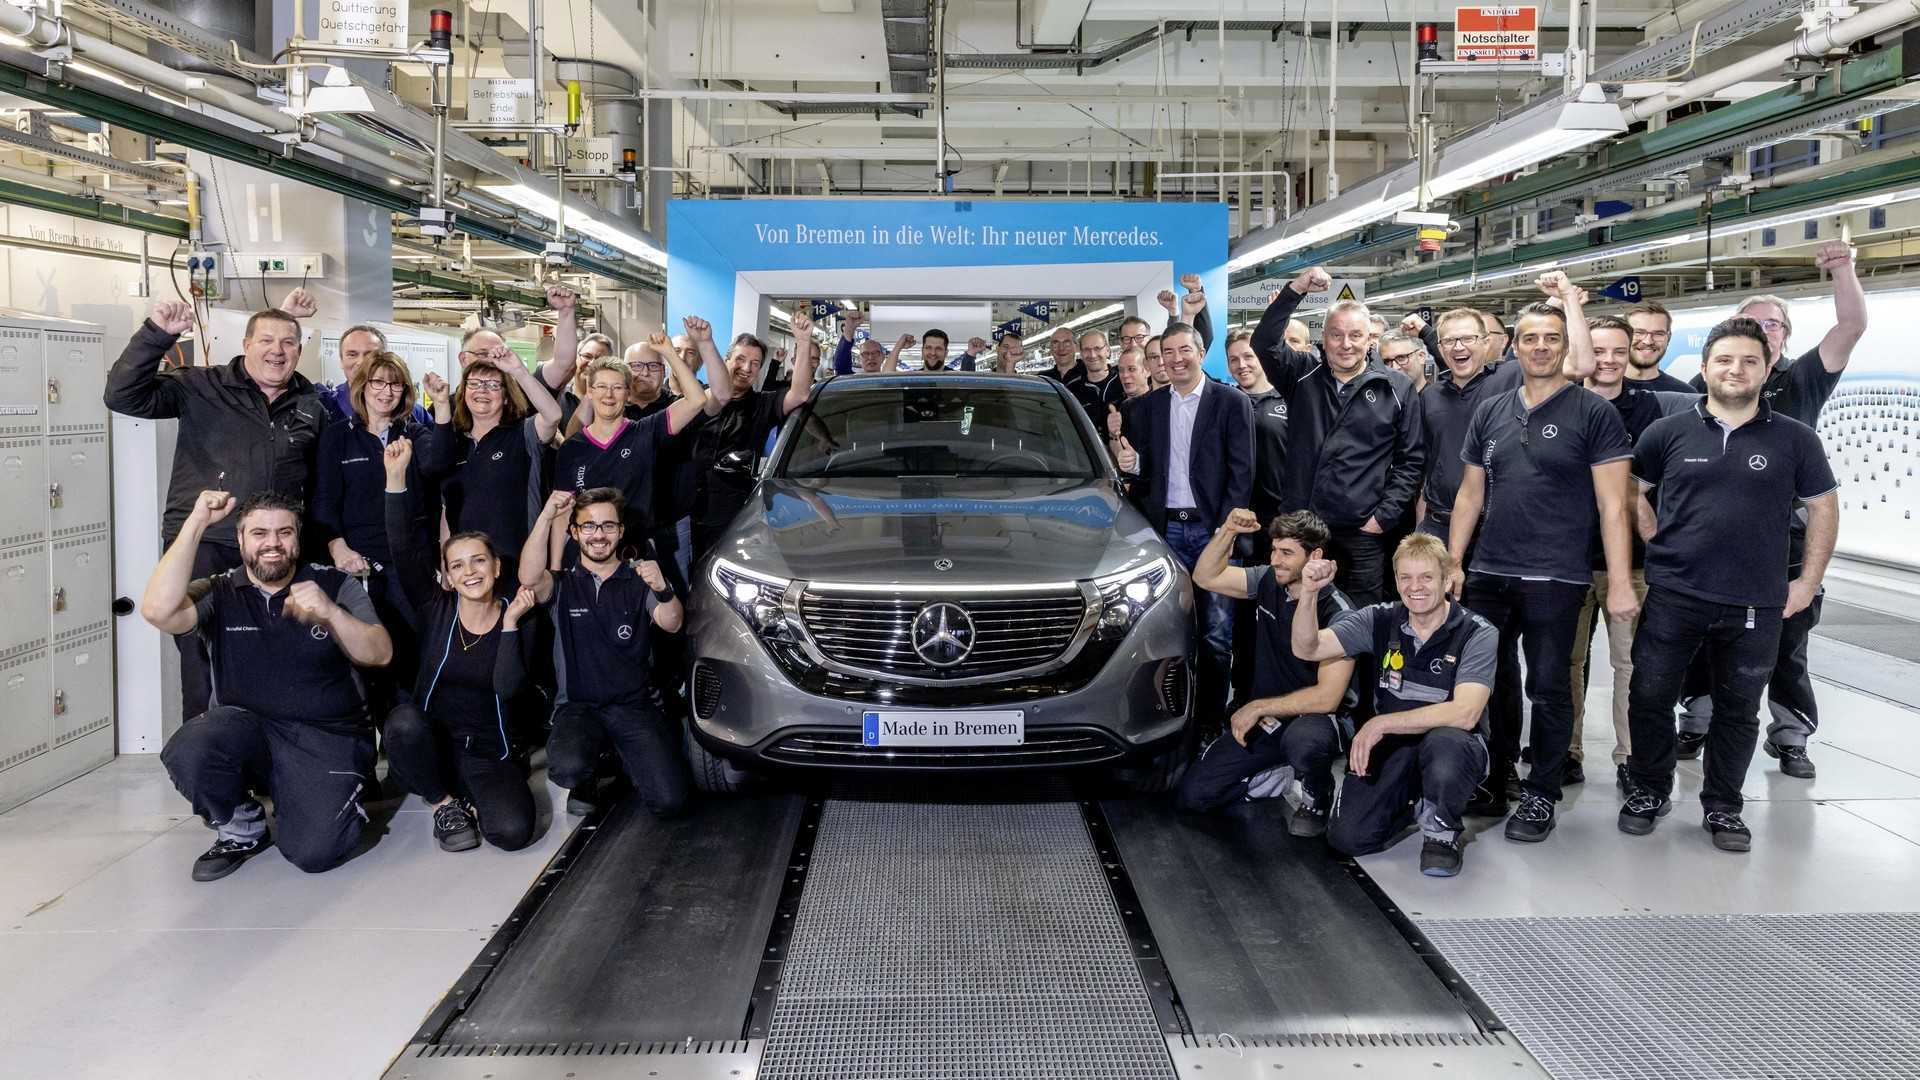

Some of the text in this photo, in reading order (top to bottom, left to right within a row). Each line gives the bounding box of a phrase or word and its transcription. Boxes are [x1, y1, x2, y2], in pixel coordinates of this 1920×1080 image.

[332, 1, 396, 18] Quittierung
[320, 18, 406, 34] Quetschgefahr
[1463, 34, 1529, 43] Notschalter
[755, 224, 1164, 246] Von Bremen in die Welt: Ihr neuer Mercedes.
[1620, 282, 1638, 297] 19
[814, 304, 828, 315] 18
[1034, 305, 1048, 316] 18
[1011, 323, 1021, 332] 17
[882, 721, 1018, 736] Made in Bremen
[868, 731, 875, 740] D
